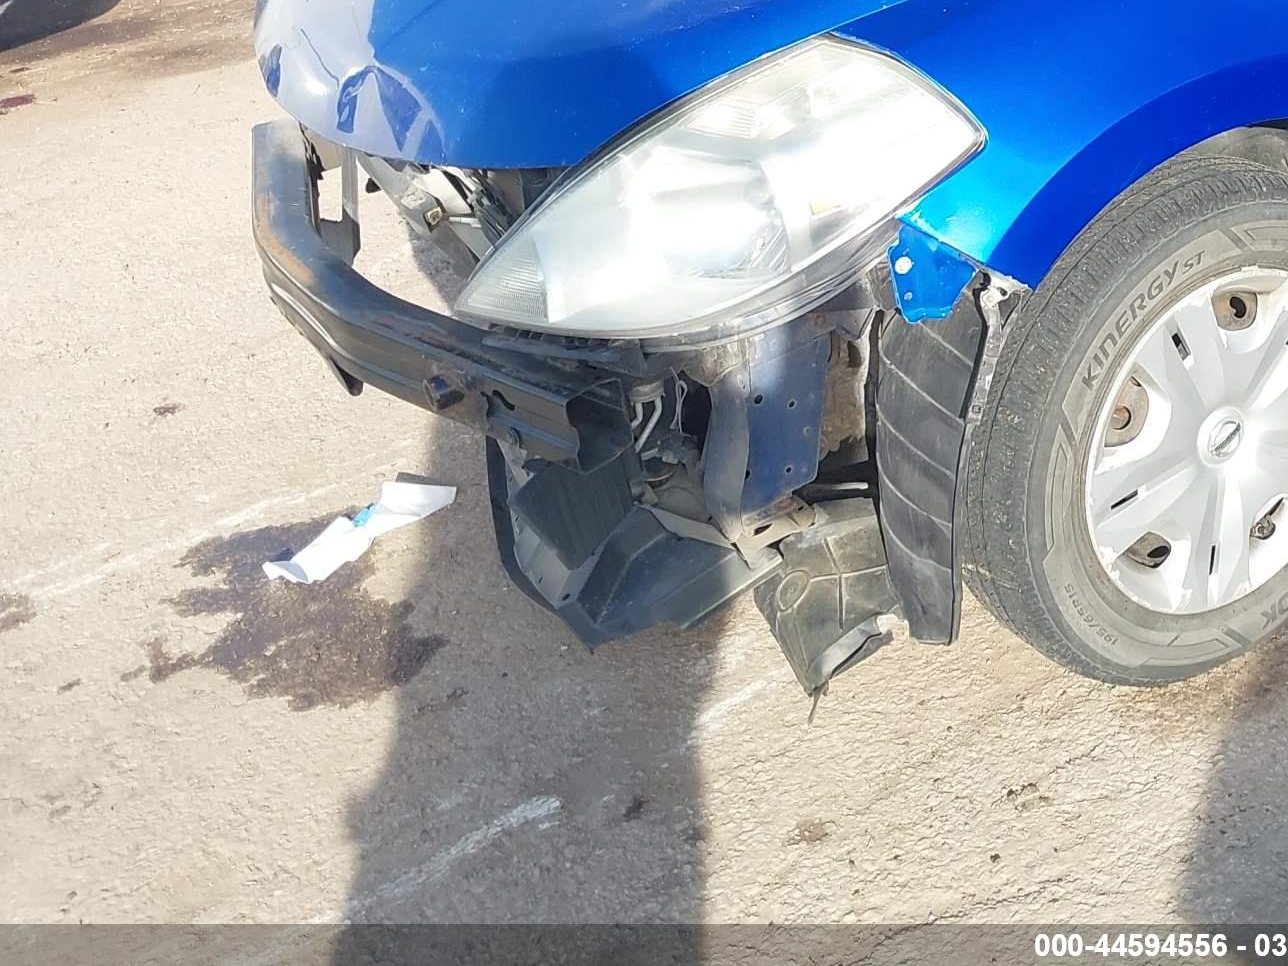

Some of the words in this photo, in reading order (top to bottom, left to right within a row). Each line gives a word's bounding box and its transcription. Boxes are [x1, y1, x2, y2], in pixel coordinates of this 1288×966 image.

[1081, 260, 1180, 392] KINERGY
[1182, 250, 1206, 275] ST
[1064, 583, 1119, 645] 195/65R15
